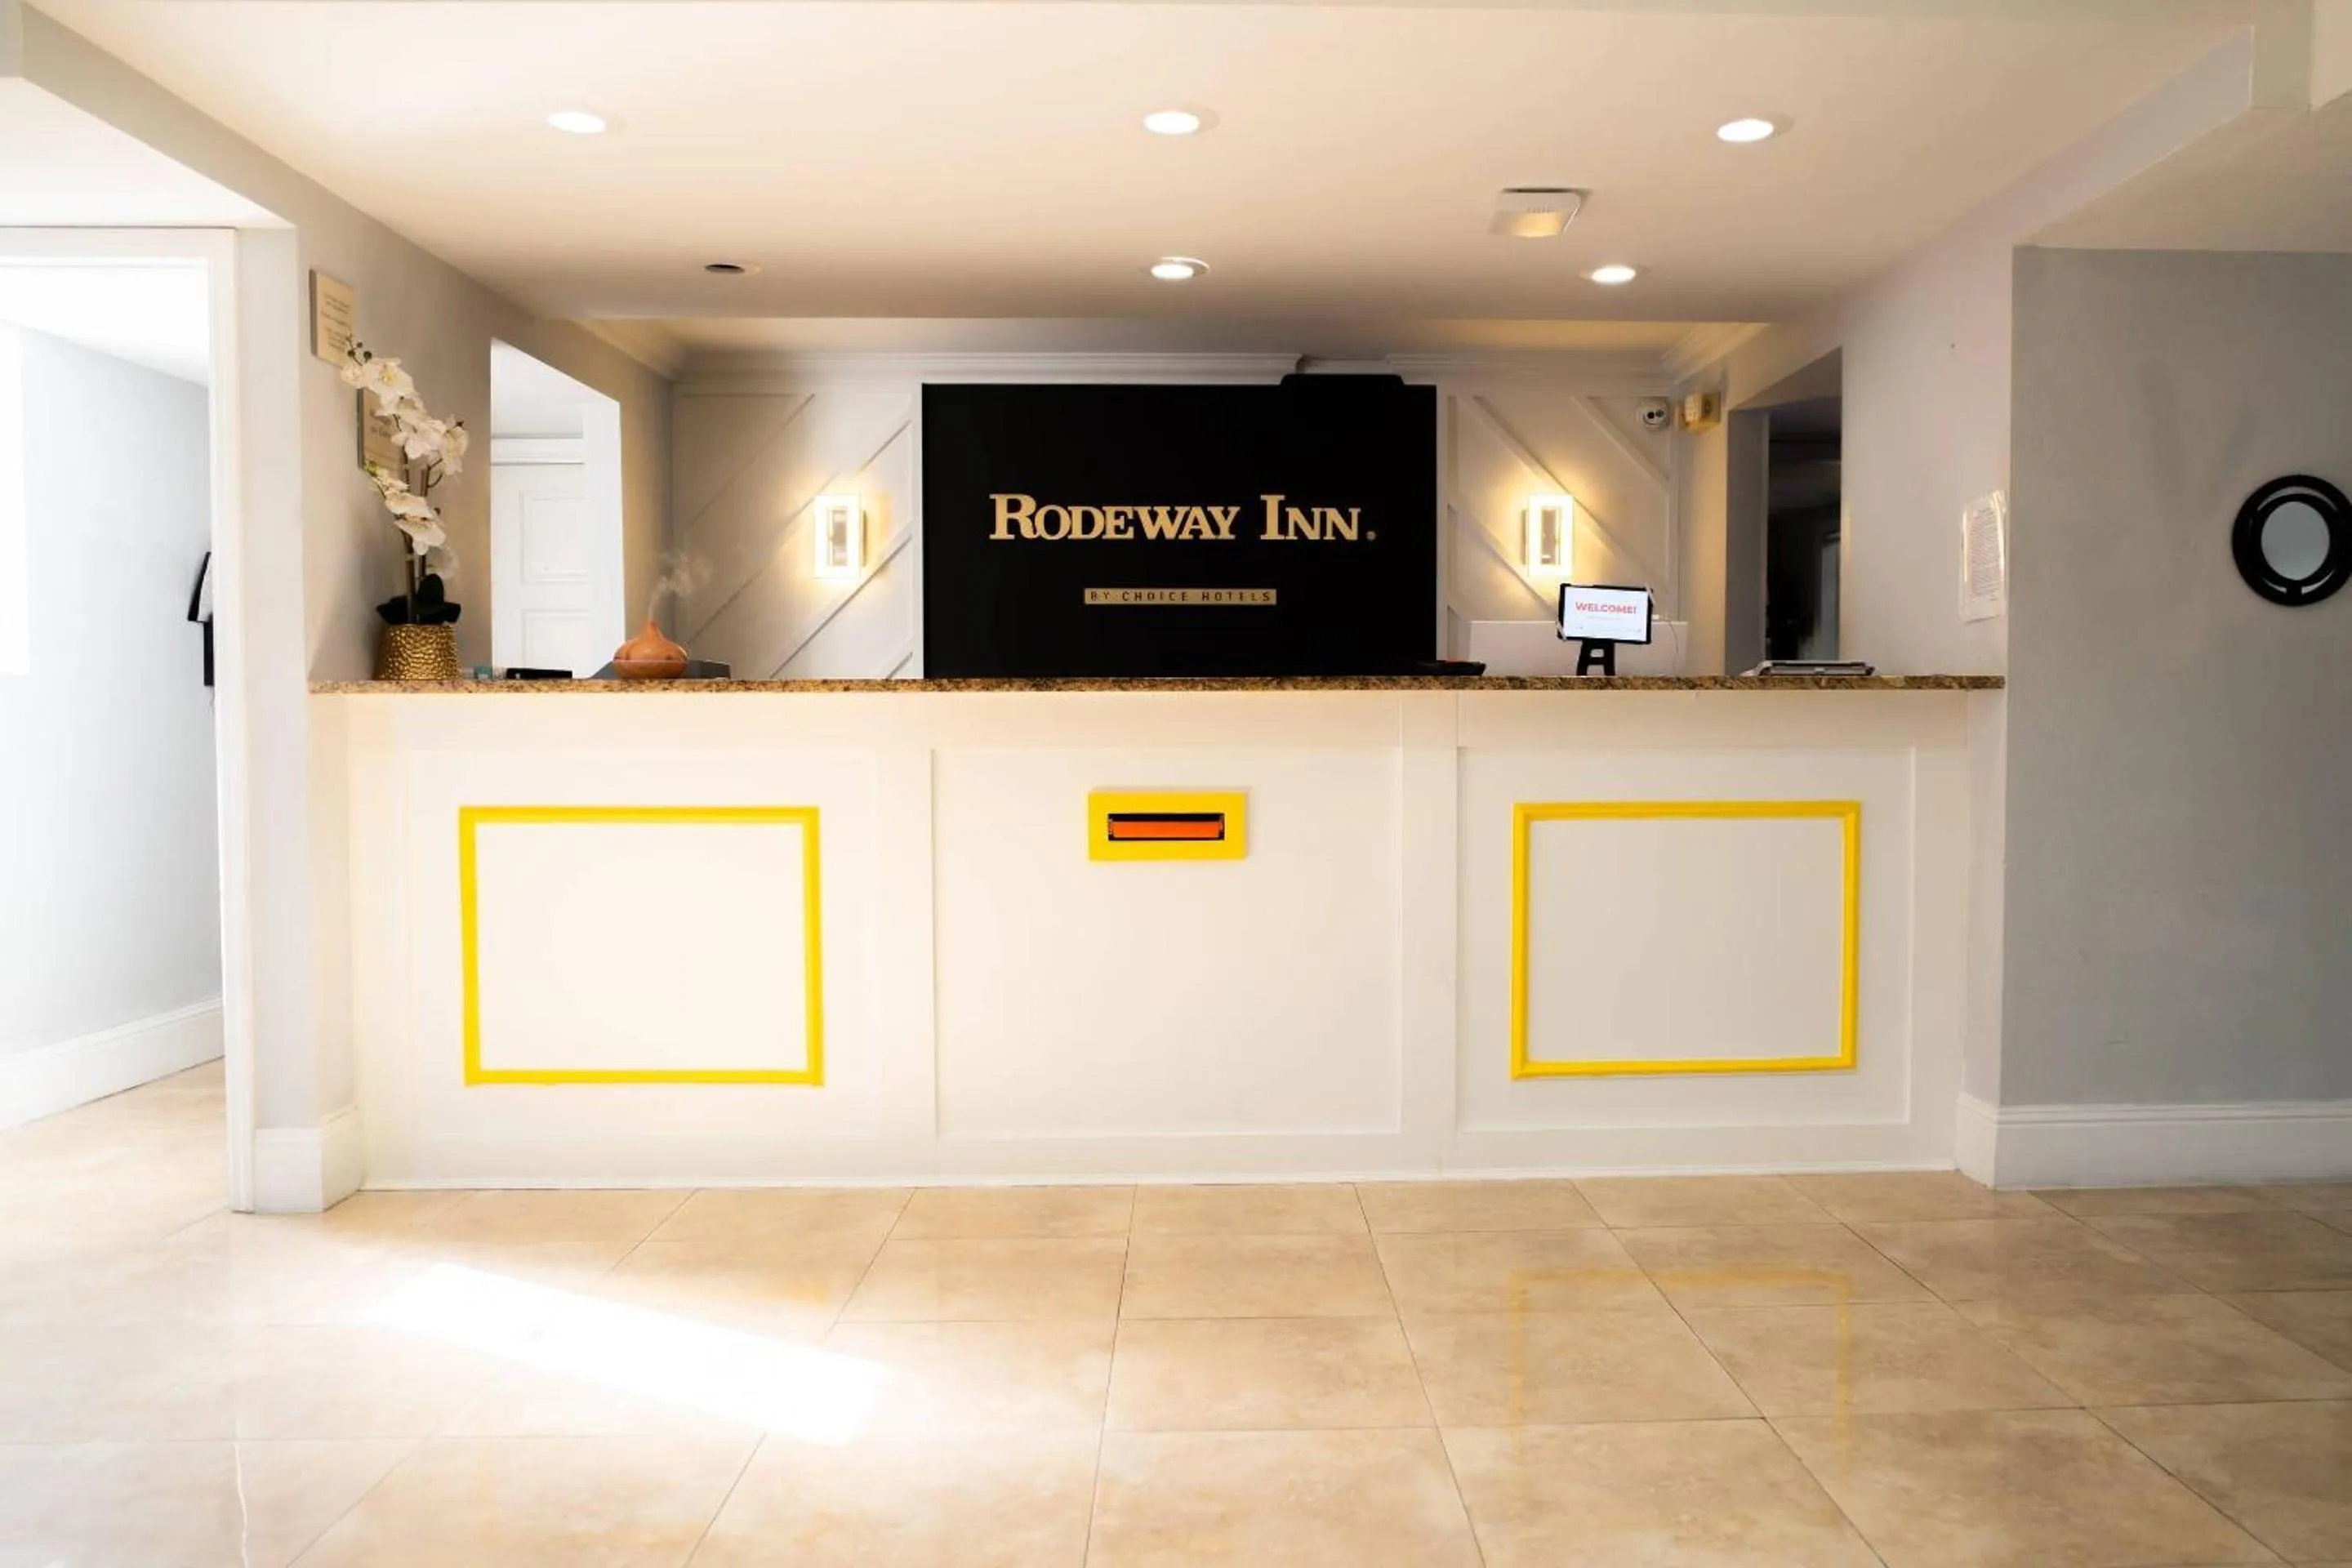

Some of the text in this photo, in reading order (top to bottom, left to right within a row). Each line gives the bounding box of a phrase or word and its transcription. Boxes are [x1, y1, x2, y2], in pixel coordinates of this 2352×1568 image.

[989, 492, 1241, 541] RODEWAY
[1090, 590, 1271, 602] BY CHOICE HOTELS
[1575, 601, 1637, 614] WELCOME!
